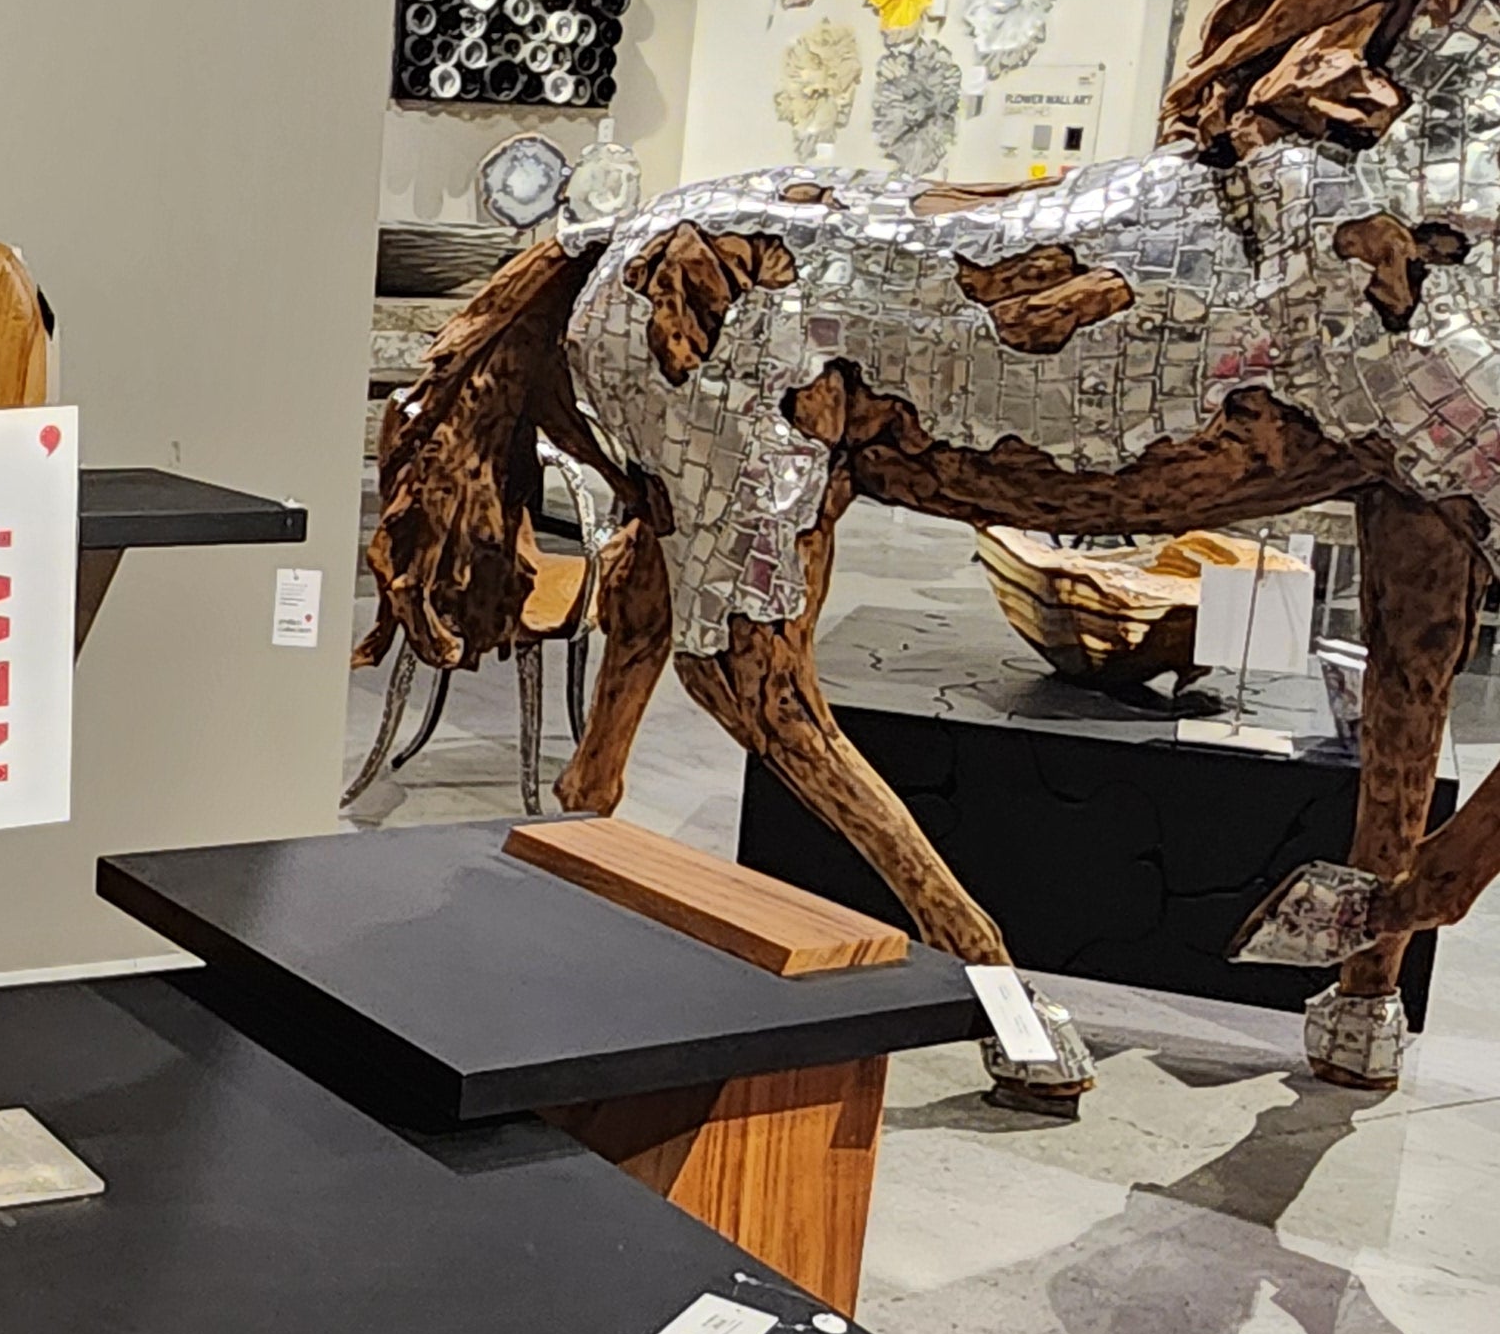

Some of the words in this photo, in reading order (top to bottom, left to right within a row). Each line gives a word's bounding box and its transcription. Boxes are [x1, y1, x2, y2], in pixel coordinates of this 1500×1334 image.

[1005, 93, 1044, 105] FLOWER
[1046, 94, 1070, 105] WALL
[1072, 94, 1093, 105] ART
